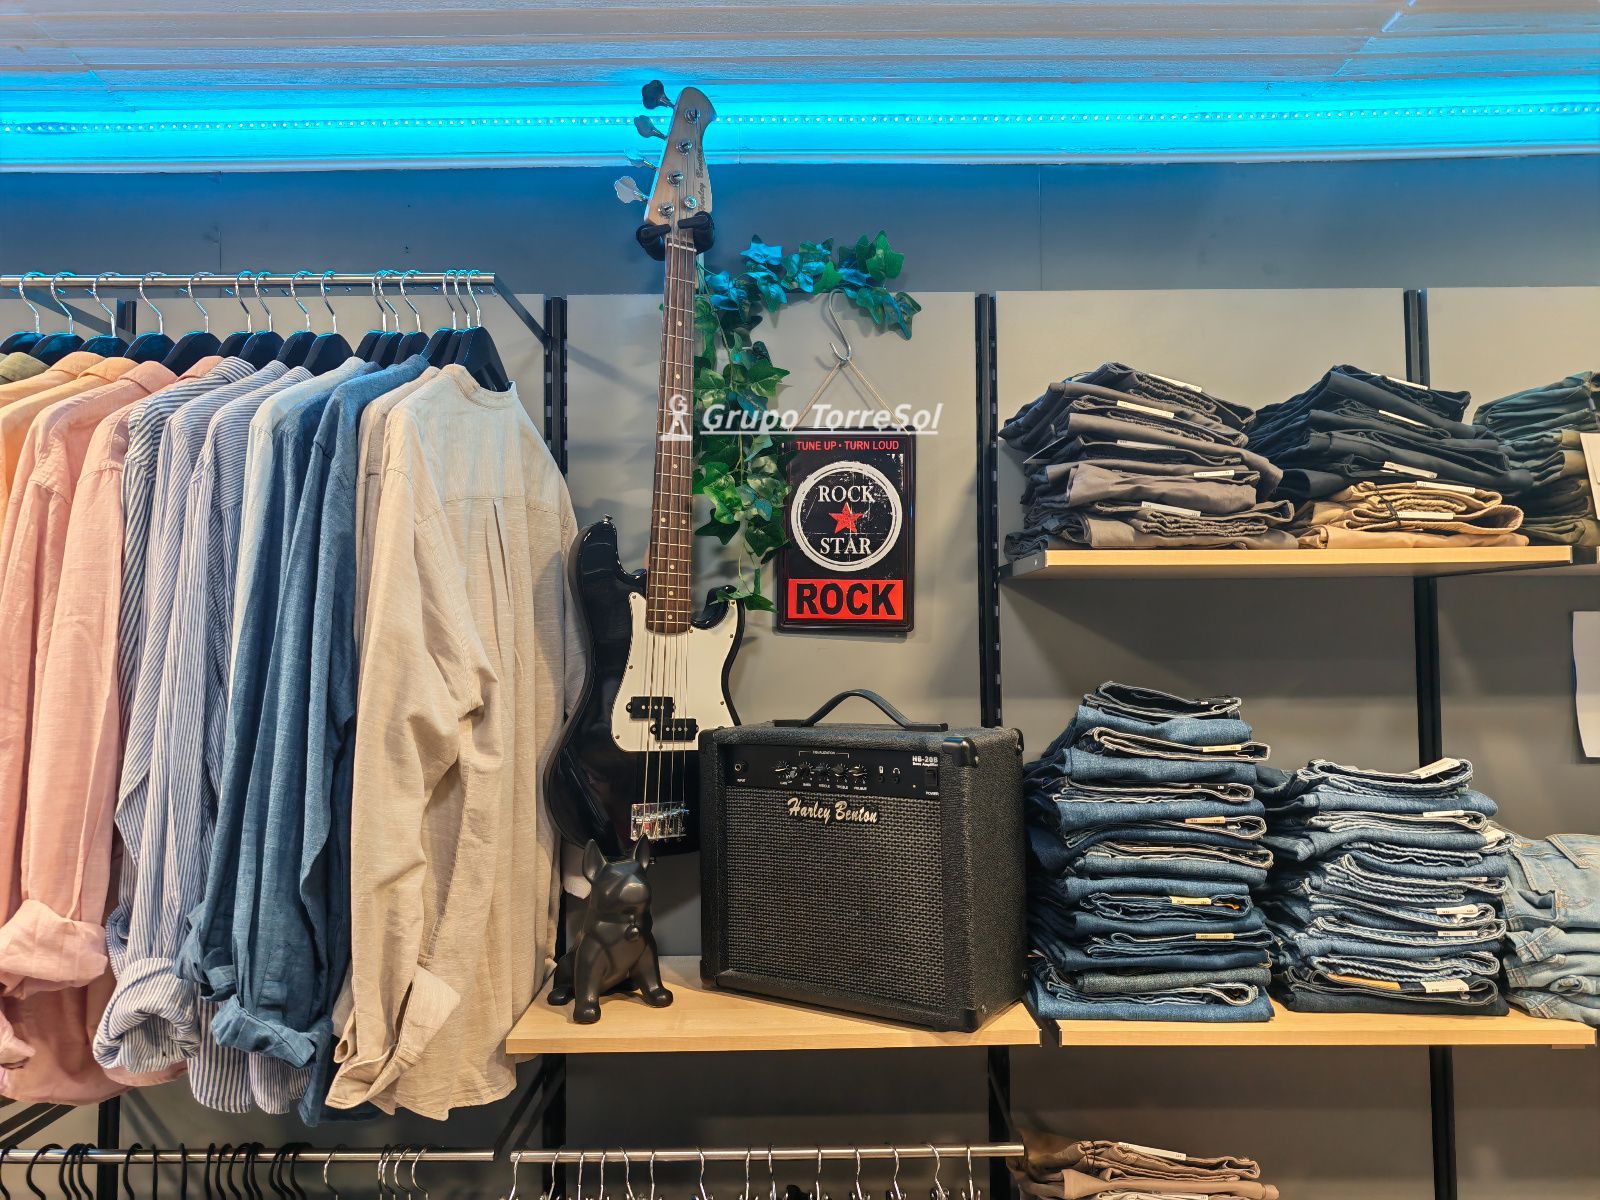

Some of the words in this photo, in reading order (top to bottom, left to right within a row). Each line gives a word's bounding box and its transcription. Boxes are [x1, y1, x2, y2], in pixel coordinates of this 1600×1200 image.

[796, 441, 821, 451] TUNE
[824, 441, 837, 451] UP
[844, 440, 870, 450] TURN
[873, 440, 899, 450] LOUD
[818, 485, 875, 503] ROCK
[820, 537, 872, 555] STAR
[796, 583, 896, 615] ROCK
[787, 798, 830, 824] Harley
[835, 801, 878, 823] Benton
